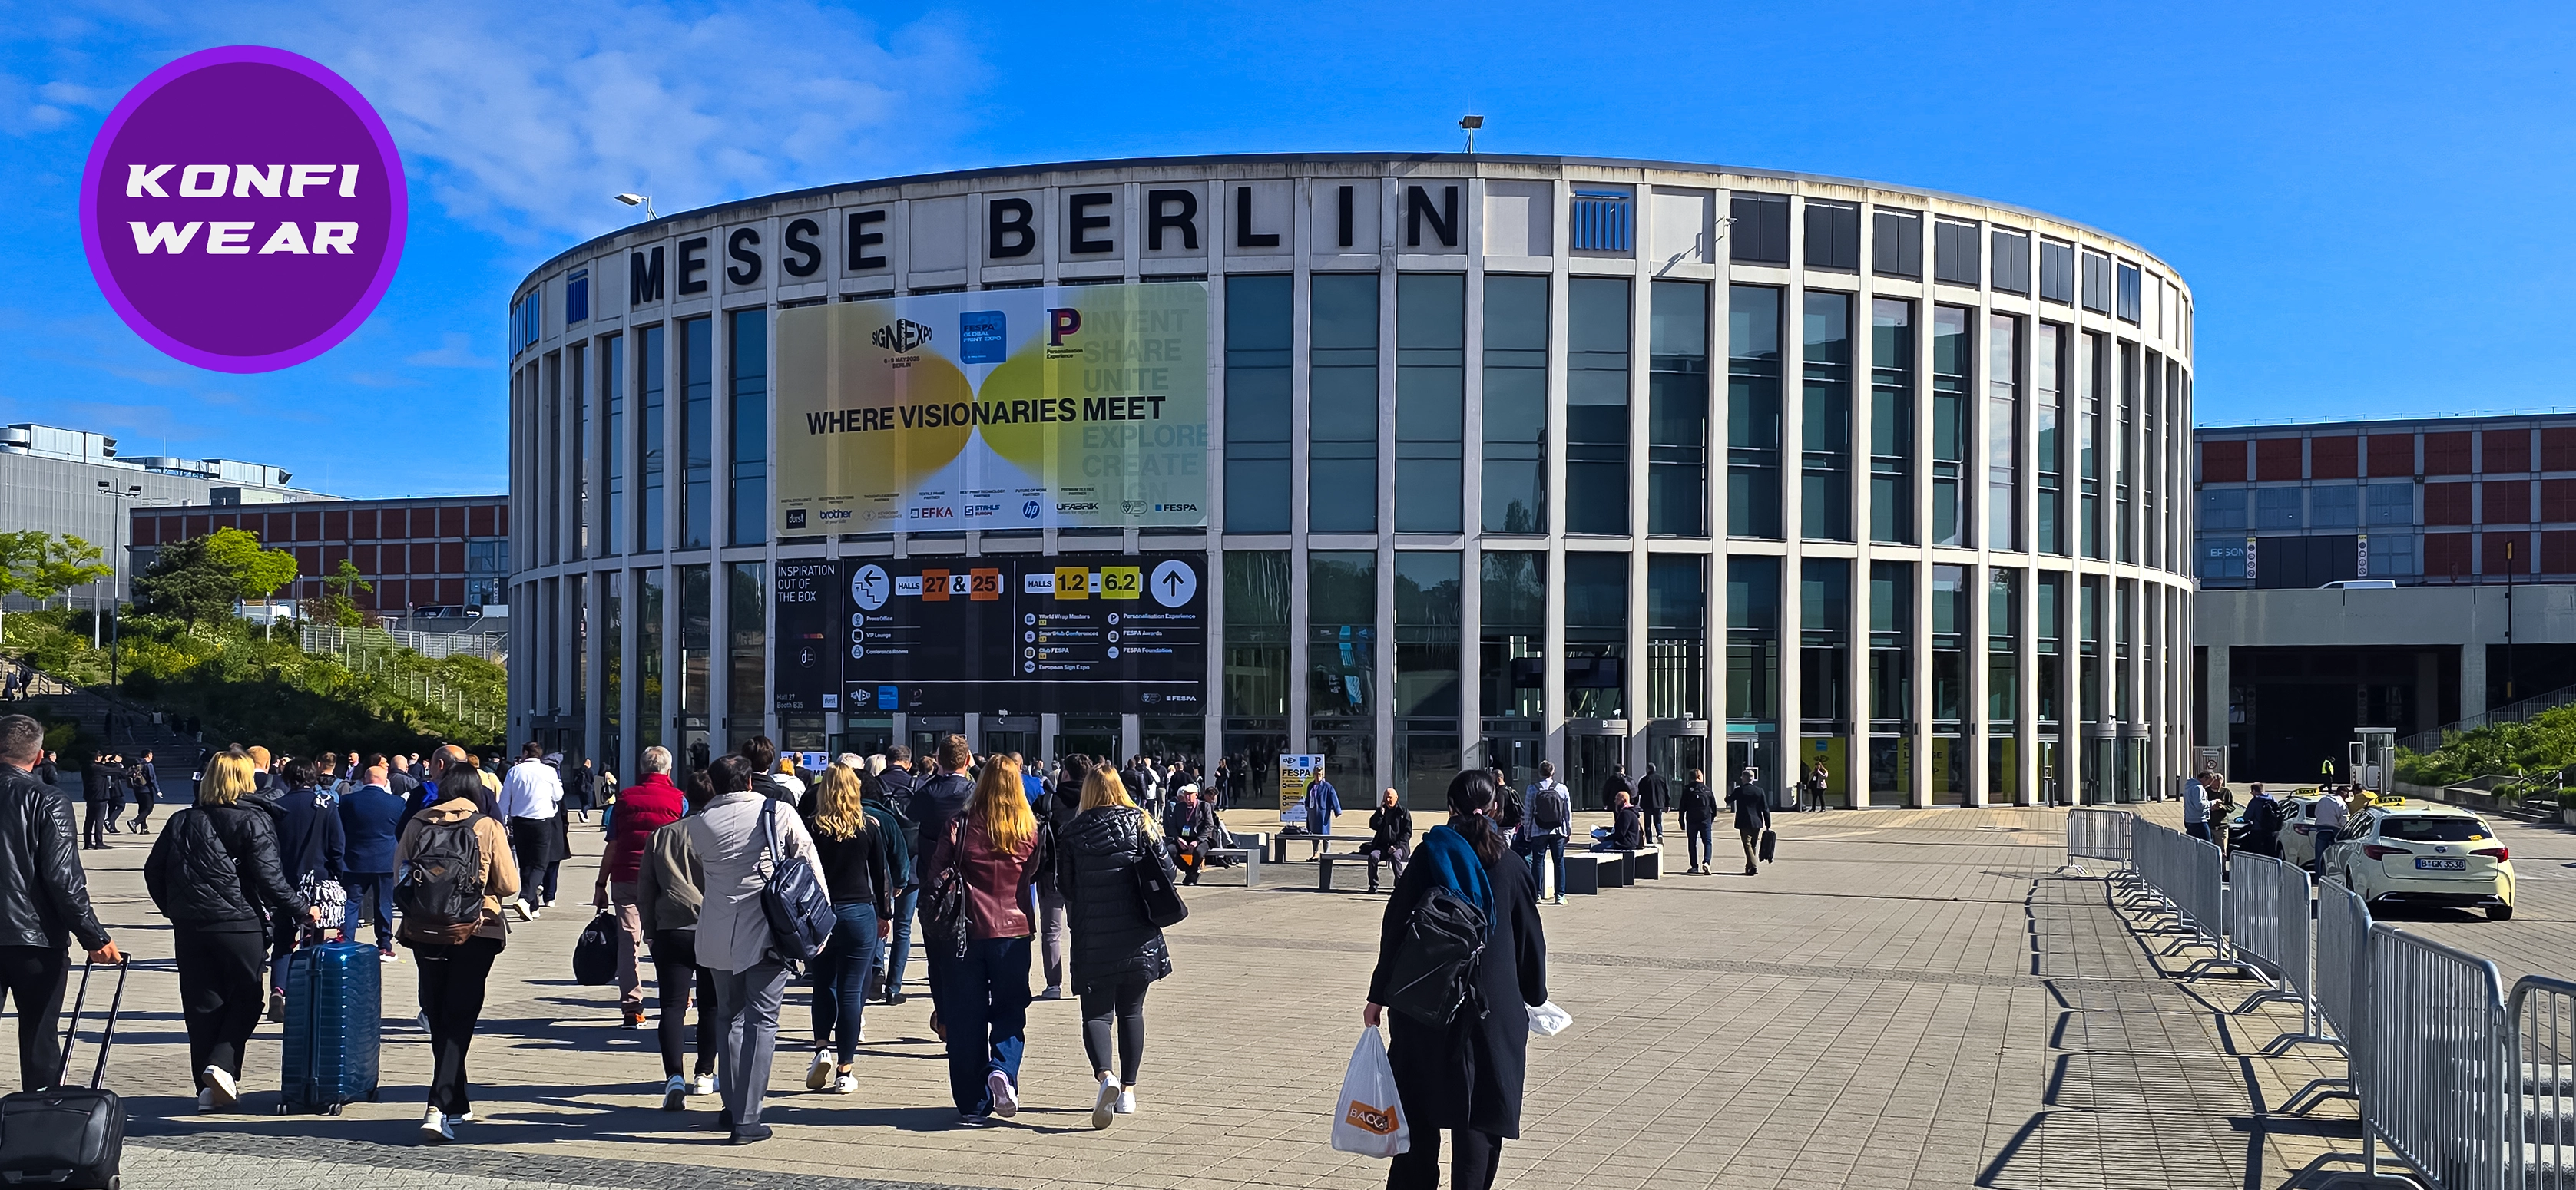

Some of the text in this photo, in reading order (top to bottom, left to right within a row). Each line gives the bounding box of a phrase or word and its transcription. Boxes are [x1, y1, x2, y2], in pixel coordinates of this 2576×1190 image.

[630, 185, 1459, 306] MESSE BERLIN
[1047, 307, 1082, 346] P
[1083, 309, 1189, 334] INVENT
[872, 319, 932, 353] SIGN EXPO
[1083, 339, 1182, 364] SHARE
[1083, 368, 1169, 392] UNITE
[806, 395, 1166, 435] WHERE VISIONARIES MEET
[1081, 453, 1199, 478] CREATE
[788, 514, 804, 524] durst
[819, 509, 853, 520] brother
[922, 507, 954, 518] EFKA
[1025, 501, 1039, 519] hp
[2210, 547, 2244, 557] EPSON
[777, 564, 835, 577] INSPIRATION
[777, 578, 810, 590] OUT OF
[925, 576, 947, 593] 27
[952, 575, 966, 593] &
[972, 575, 996, 593] 25
[1058, 574, 1084, 591] 1.2
[1104, 574, 1136, 590] 6.2
[777, 590, 816, 603] THE BOX
[1282, 769, 1311, 777] FESPA
